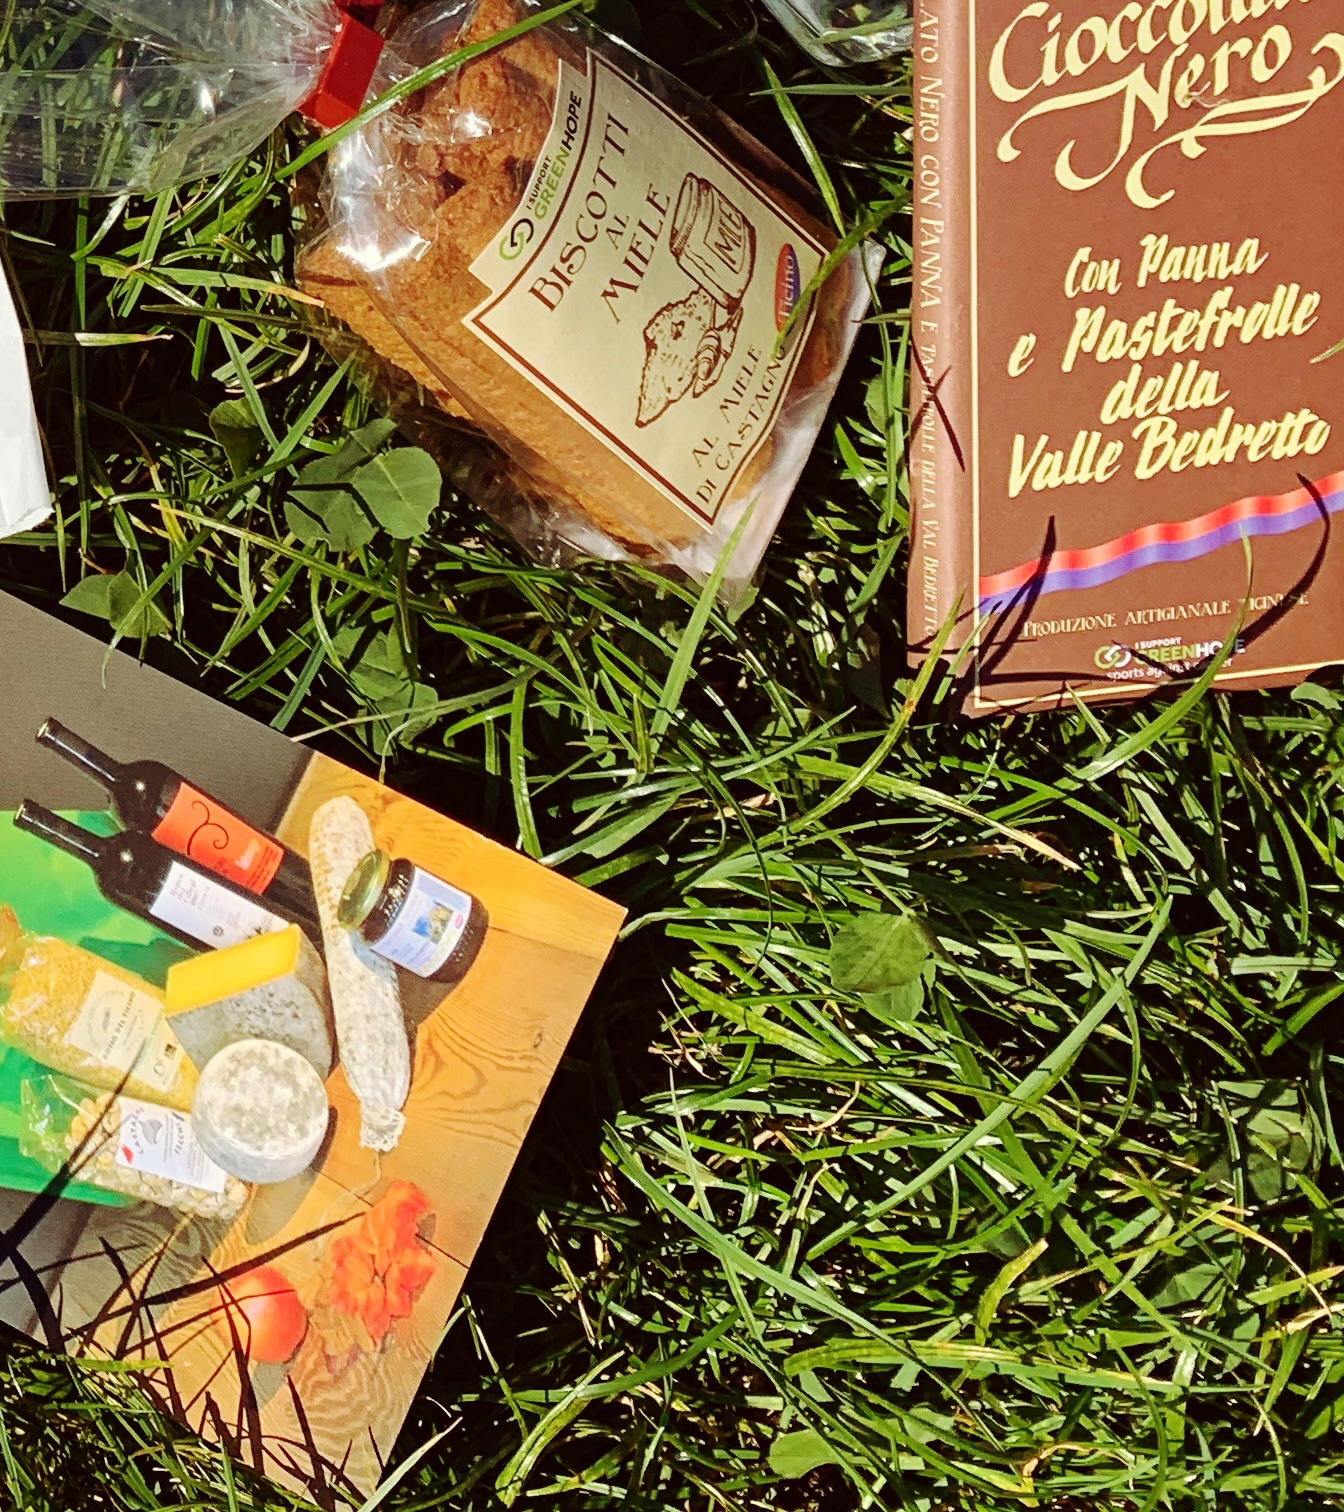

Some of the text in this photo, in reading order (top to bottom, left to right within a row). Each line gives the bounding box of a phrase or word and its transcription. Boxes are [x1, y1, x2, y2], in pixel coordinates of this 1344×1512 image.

[919, 75, 943, 144] NERO
[1054, 25, 1294, 189] Nero
[528, 155, 552, 203] SUPPORT
[534, 90, 583, 220] GREENHOPE
[919, 155, 944, 208] CON
[527, 112, 631, 314] BISCOTTI
[608, 214, 629, 252] AL
[601, 183, 671, 325] MIELE
[919, 215, 944, 309] PANNA
[1065, 233, 1268, 299] Con Panna
[778, 254, 795, 324] Ticino
[920, 319, 938, 333] E
[1008, 283, 1320, 378] e Pastefrolle
[691, 347, 763, 469] AL MIELE
[696, 344, 787, 504] DI CASTAGNO
[1100, 359, 1230, 425] della
[921, 459, 937, 509] DELLA
[1009, 407, 1331, 498] Valle Bedretto
[922, 519, 939, 552] VAL
[1124, 599, 1231, 626] ARTIGIANALE
[1140, 637, 1182, 649] SUPPORT
[1107, 667, 1145, 681] sports
[1134, 639, 1246, 666] GREENHOE
